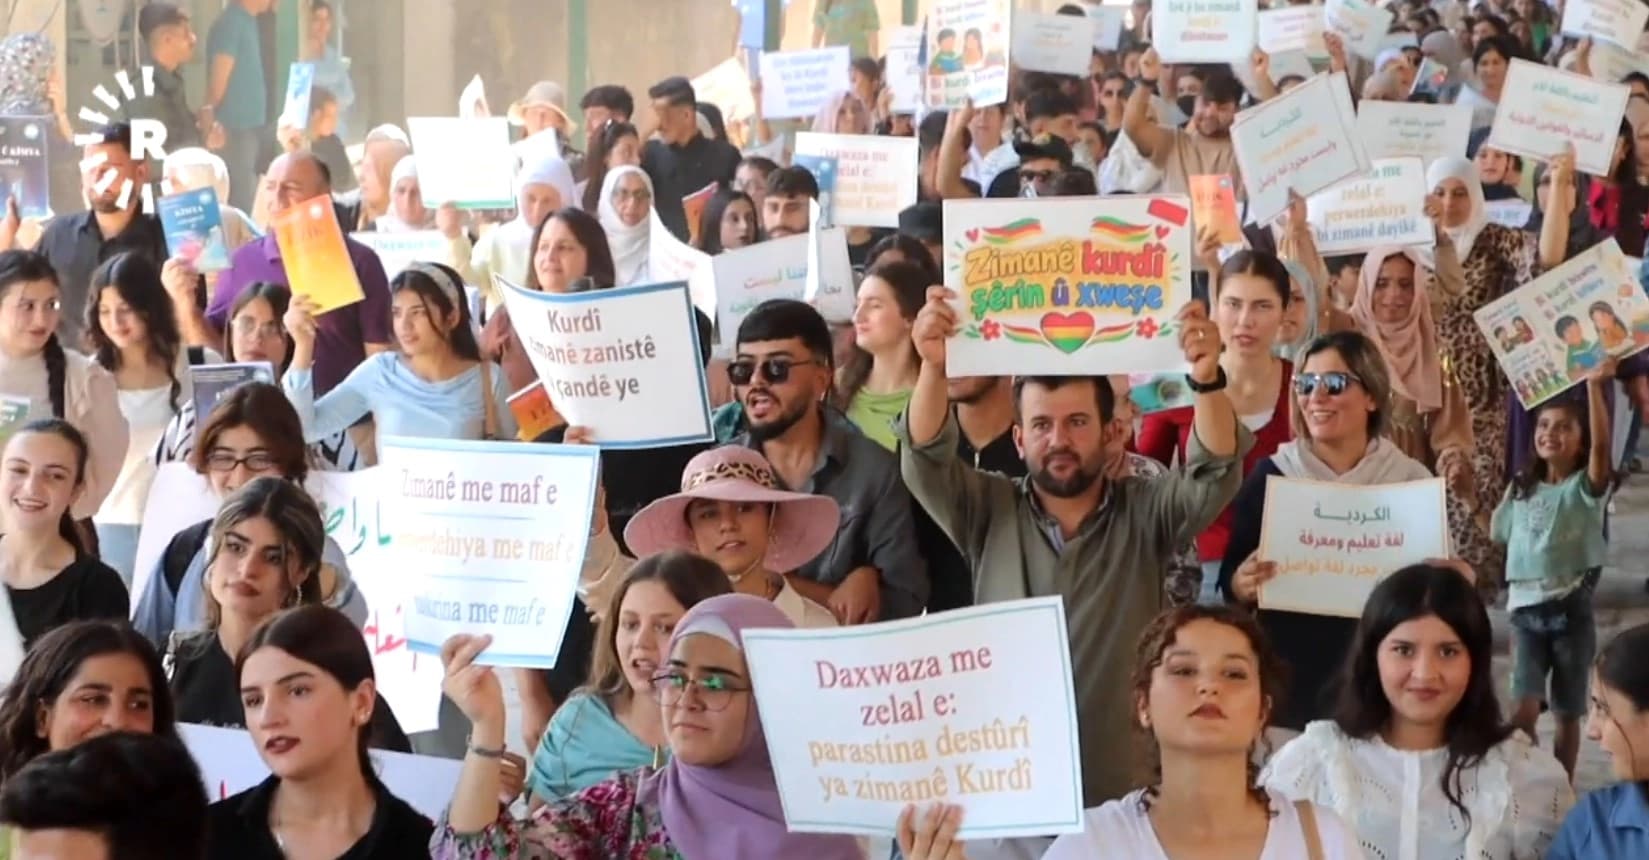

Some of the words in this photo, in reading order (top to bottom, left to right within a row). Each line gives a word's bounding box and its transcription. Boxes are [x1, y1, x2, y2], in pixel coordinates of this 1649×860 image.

[965, 240, 1076, 286] Zimanê
[1081, 240, 1168, 279] kurdî
[970, 279, 1046, 321] şêrîn
[1051, 277, 1071, 307] û
[1076, 282, 1164, 316] xweşe
[547, 307, 603, 334] Kurdî
[583, 336, 656, 365] zanistê
[616, 377, 640, 402] ye
[401, 468, 456, 501] Zimanê
[461, 479, 493, 502] me
[499, 474, 544, 504] maf
[546, 483, 558, 505] e
[492, 538, 523, 560] me
[529, 532, 565, 562] maf
[1298, 530, 1344, 551] ومعرفة
[1346, 532, 1381, 553] تعليم
[1385, 531, 1405, 548] لغة
[468, 601, 499, 625] me
[503, 597, 539, 626] maf
[535, 606, 546, 626] e
[815, 655, 943, 690] Daxwaza
[951, 646, 994, 675] me
[860, 690, 924, 727] zelal
[933, 692, 957, 716] e:
[808, 733, 929, 768] parastina
[935, 715, 1034, 758] destûrî
[818, 774, 848, 804] ya
[853, 767, 949, 801] zimanê
[955, 758, 1034, 795] Kurdî
